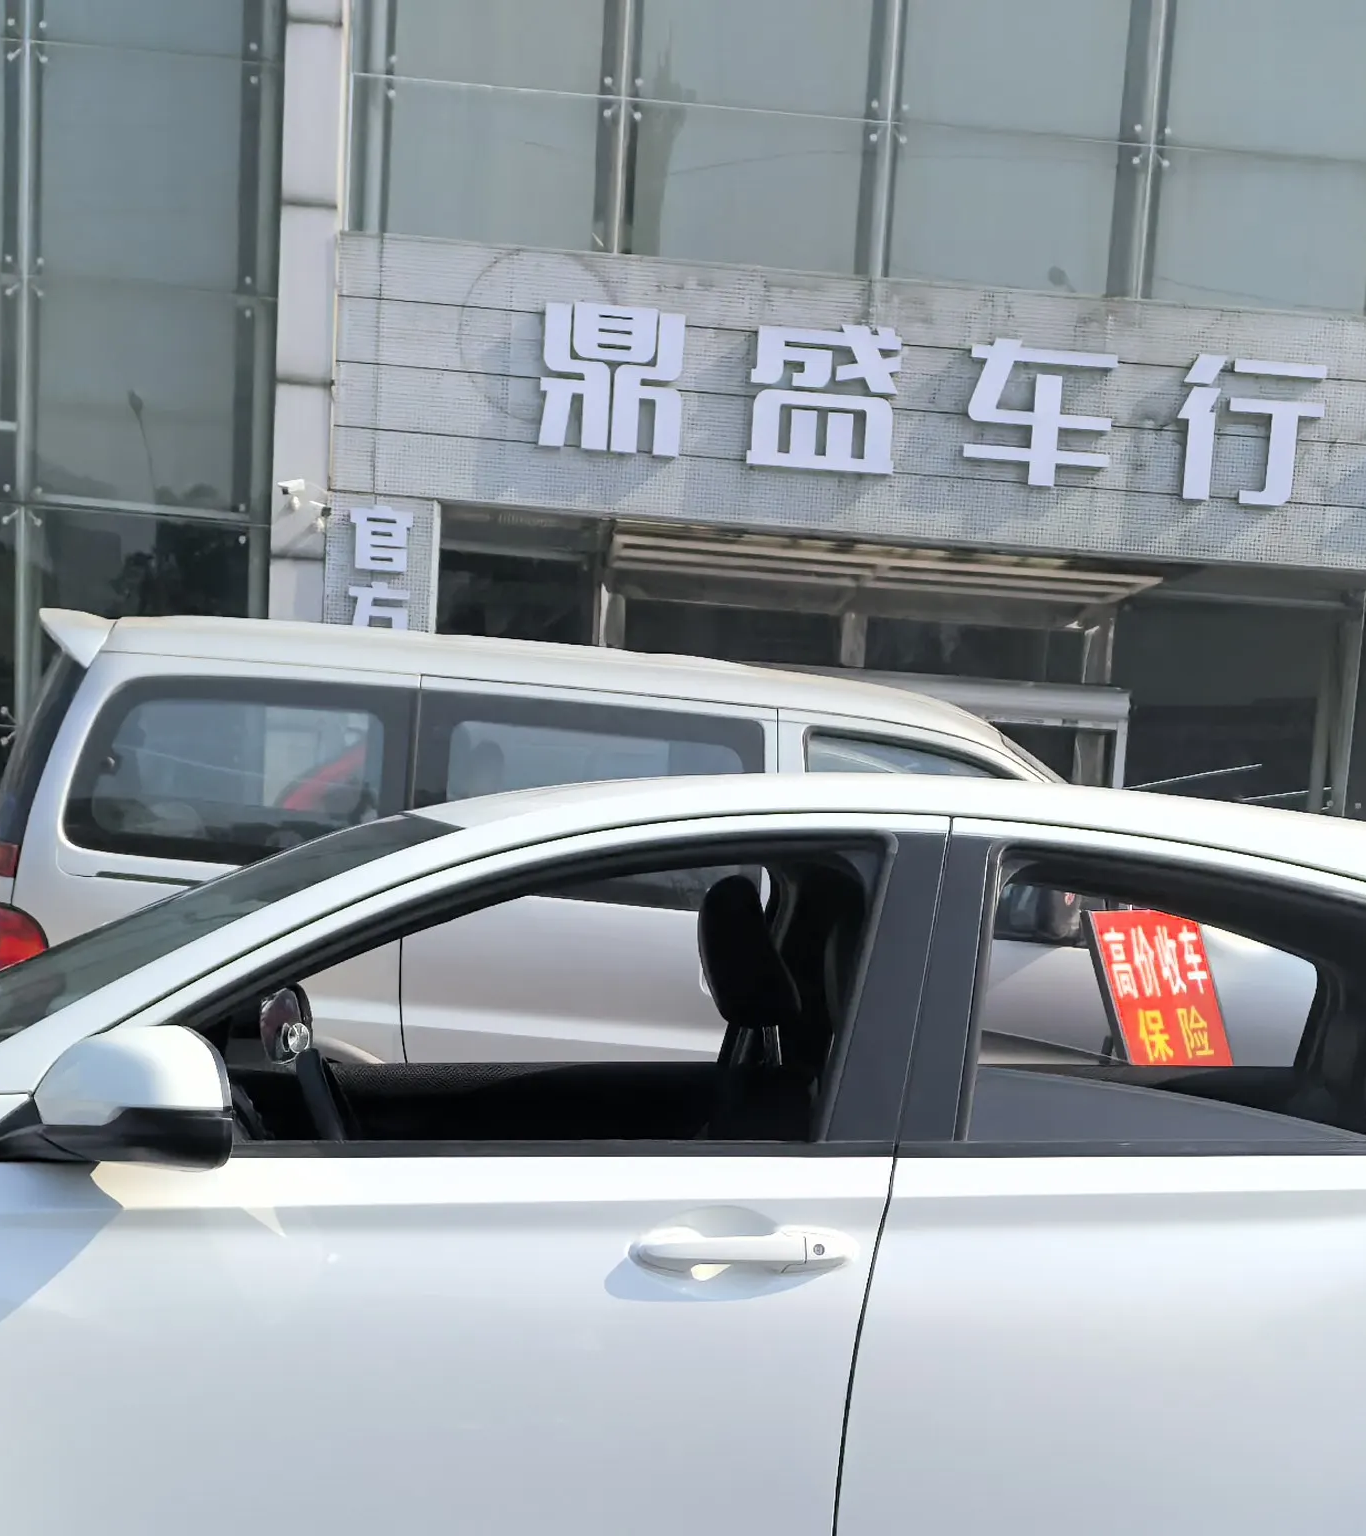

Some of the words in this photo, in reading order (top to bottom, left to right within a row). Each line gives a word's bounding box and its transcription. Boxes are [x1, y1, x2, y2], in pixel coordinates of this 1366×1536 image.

[537, 301, 1328, 507] 鼎盛车行
[348, 505, 415, 631] 官方
[1103, 925, 1208, 998] 高价收车
[1137, 1005, 1215, 1063] 保险
